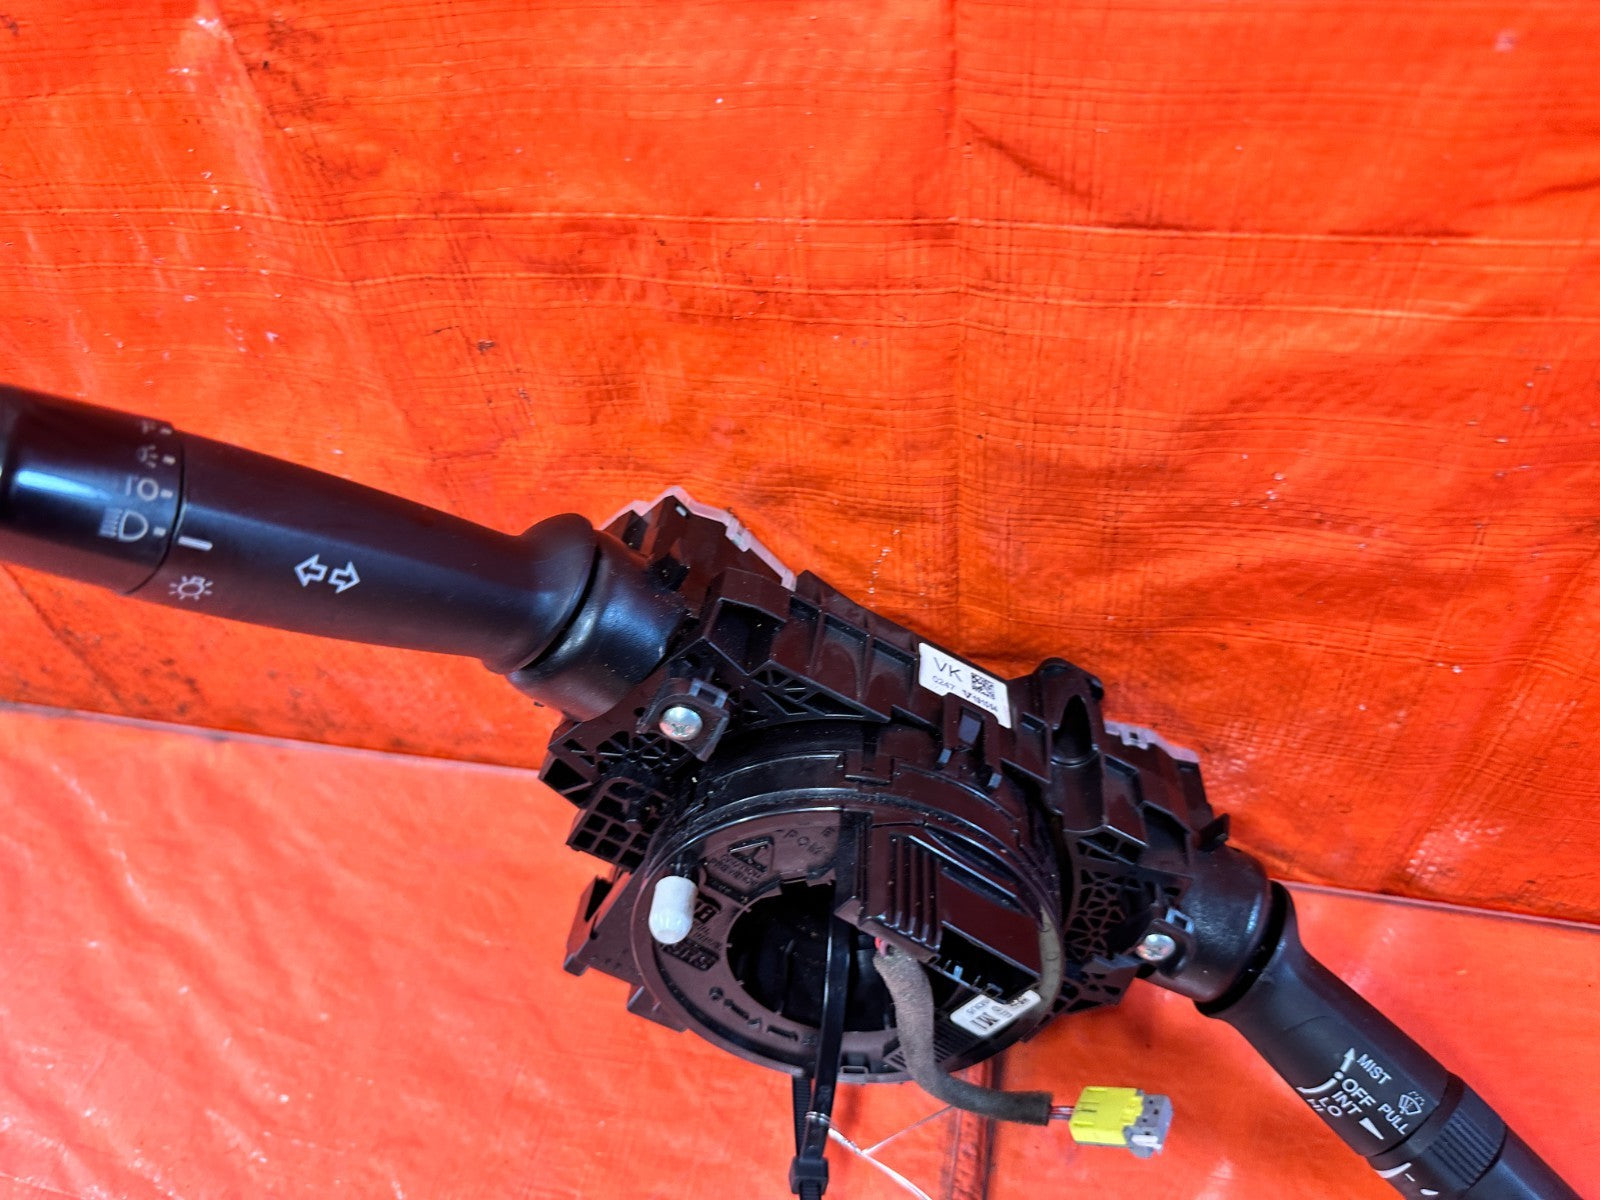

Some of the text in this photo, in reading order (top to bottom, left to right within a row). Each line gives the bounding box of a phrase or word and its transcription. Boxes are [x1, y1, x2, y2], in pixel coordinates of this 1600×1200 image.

[933, 656, 962, 682] VK
[1356, 1053, 1392, 1085] MIST
[1331, 1090, 1363, 1115] INT
[1341, 1078, 1376, 1107] OFF
[1318, 1096, 1343, 1117] LO
[1377, 1103, 1409, 1135] PULL
